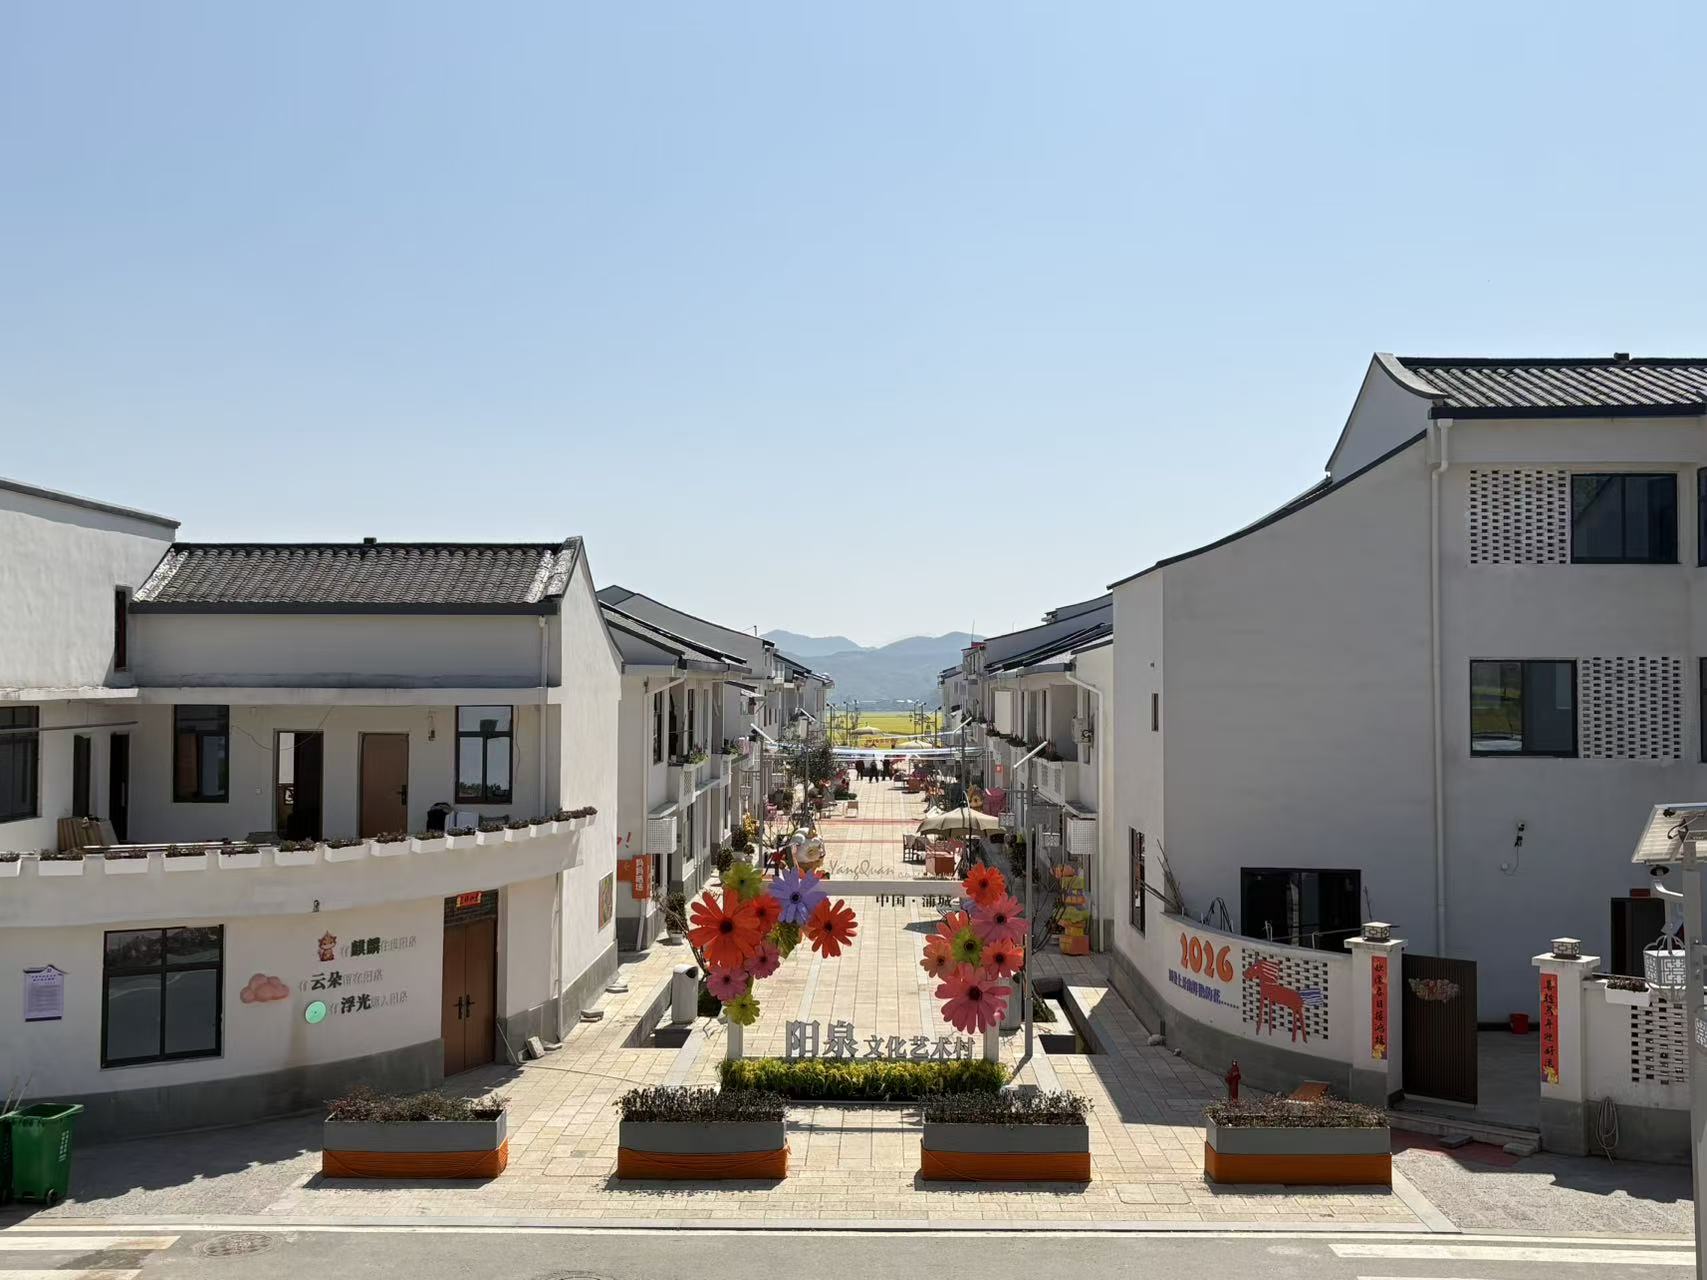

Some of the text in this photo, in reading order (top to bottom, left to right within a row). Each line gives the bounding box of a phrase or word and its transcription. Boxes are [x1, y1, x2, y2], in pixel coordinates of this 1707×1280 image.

[1180, 932, 1234, 983] 2026
[786, 1020, 976, 1059] 阳泉 文化艺术村
